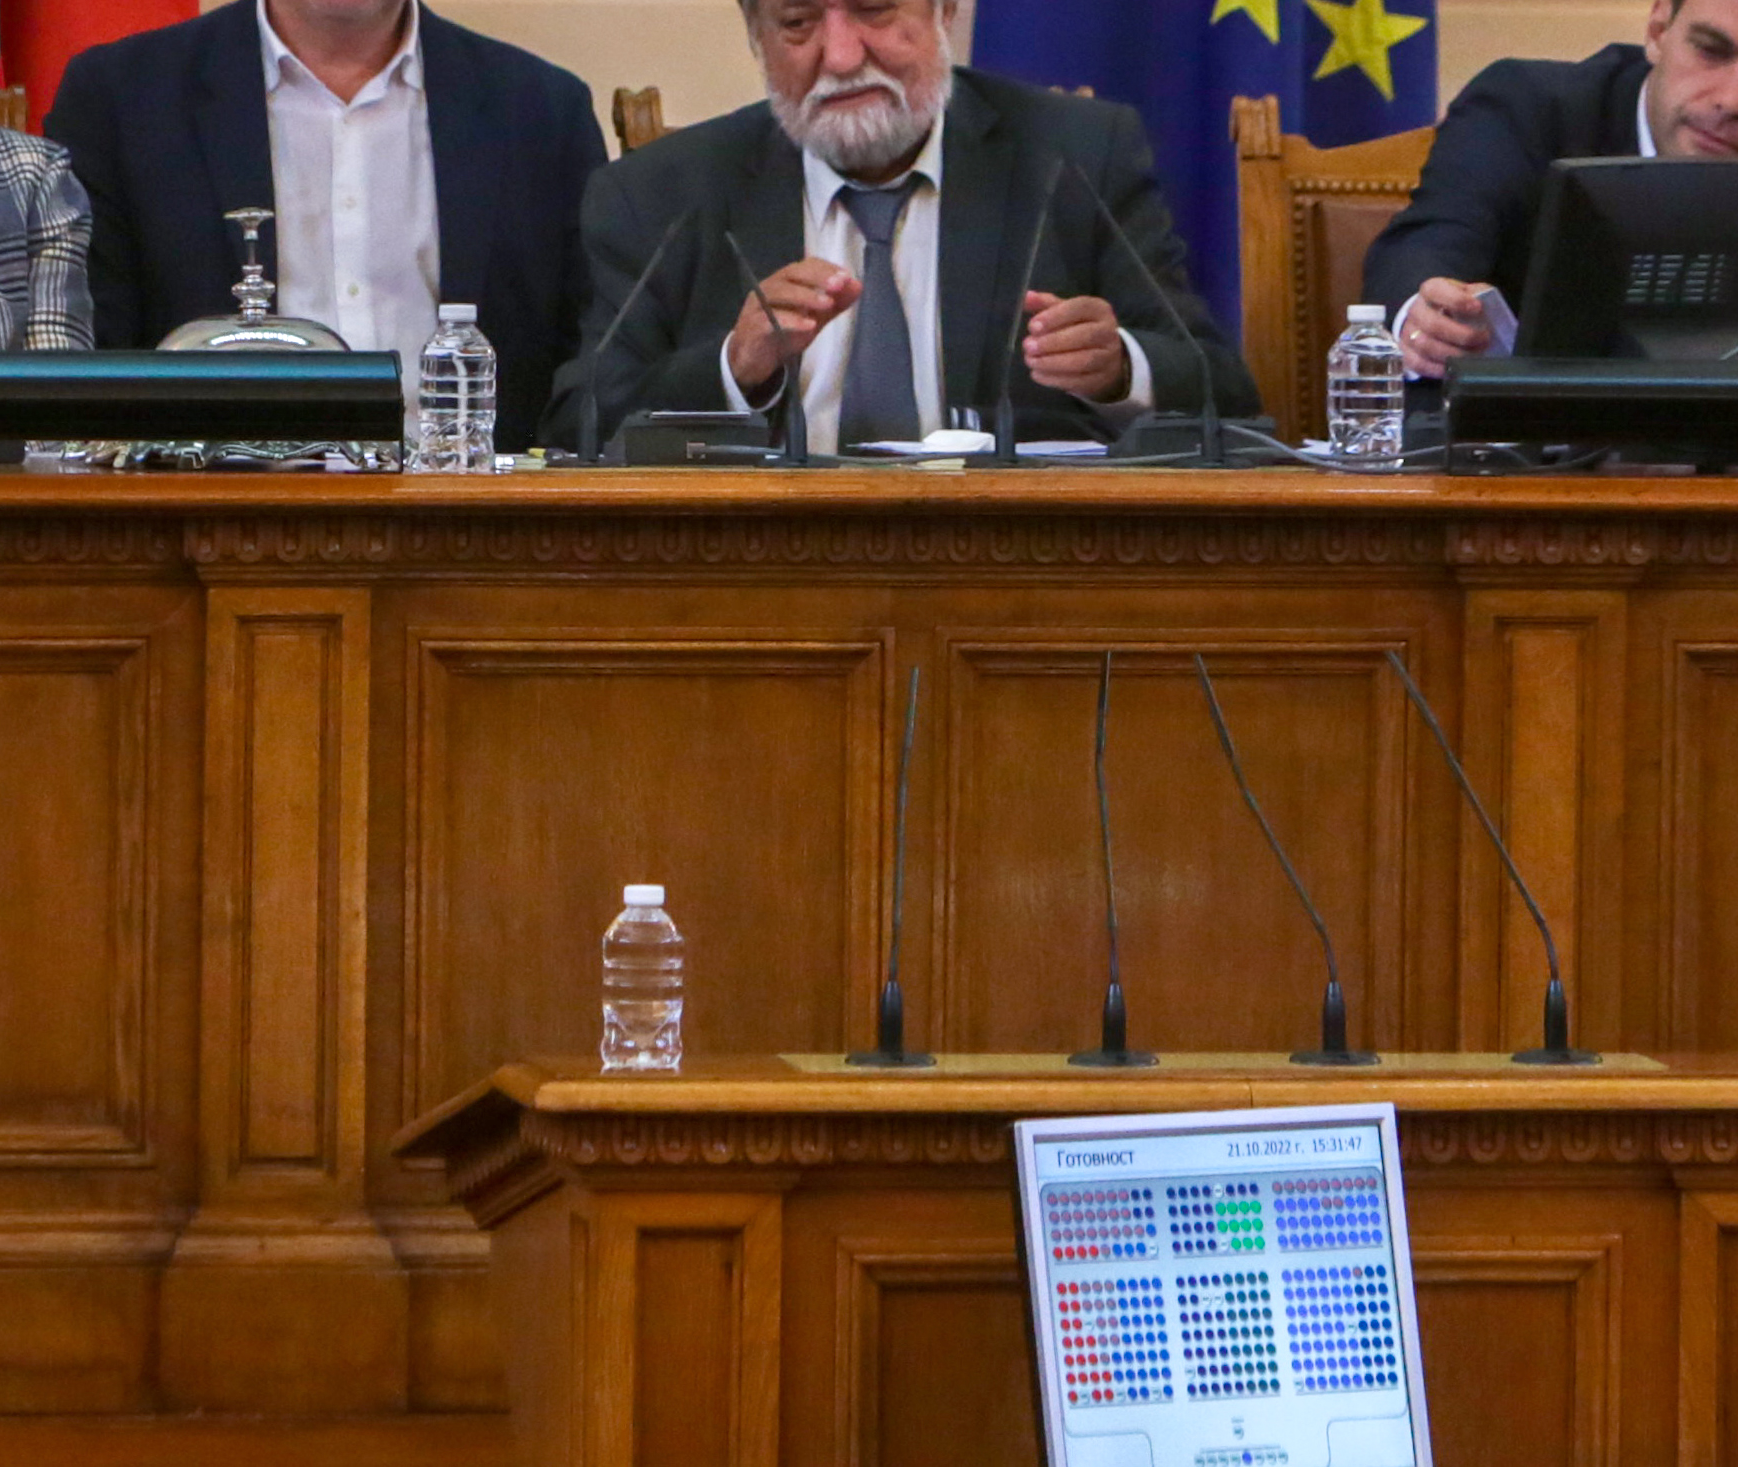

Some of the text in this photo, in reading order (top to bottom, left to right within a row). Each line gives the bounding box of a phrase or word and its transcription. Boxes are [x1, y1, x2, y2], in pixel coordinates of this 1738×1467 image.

[1227, 1140, 1291, 1157] 21.10.2022
[1312, 1137, 1363, 1153] 15:31:47
[1057, 1149, 1135, 1167] Готовност
